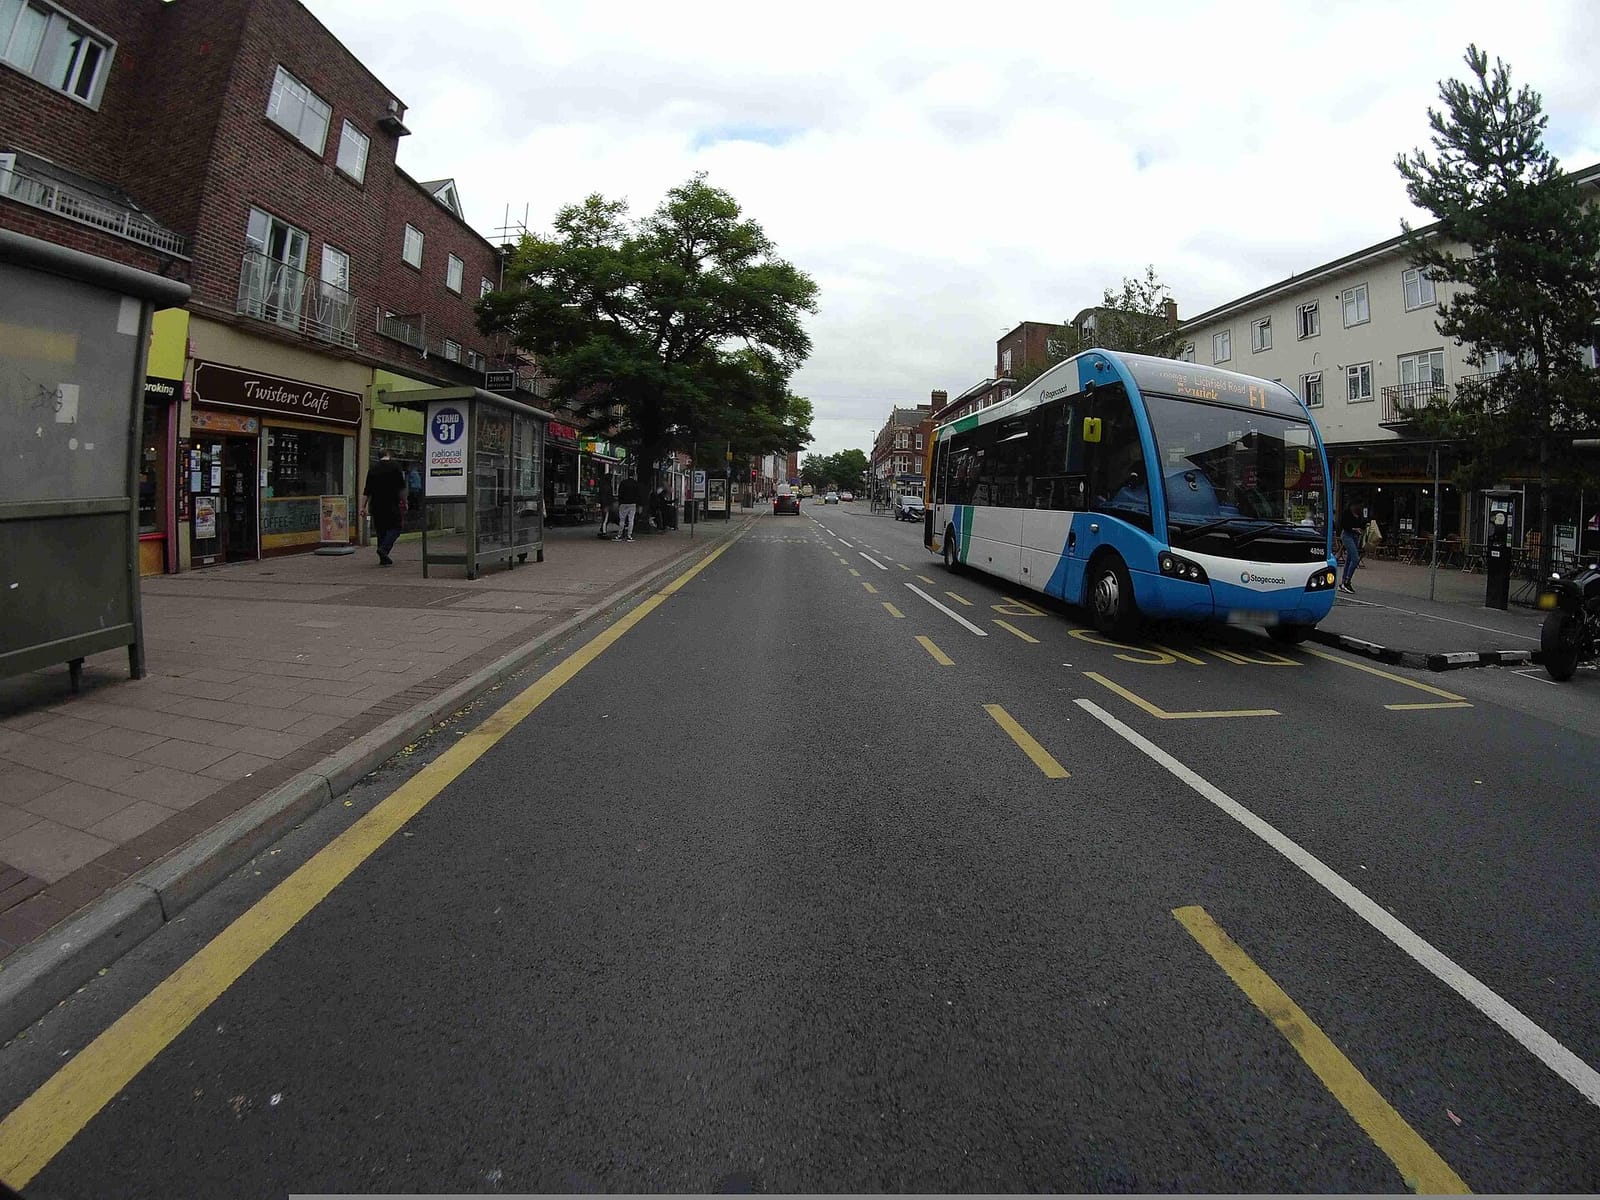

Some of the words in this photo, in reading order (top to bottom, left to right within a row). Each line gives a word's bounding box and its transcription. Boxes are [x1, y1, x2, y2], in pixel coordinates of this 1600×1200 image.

[1045, 384, 1069, 399] Stagecoach
[1228, 381, 1246, 394] Road
[244, 381, 300, 405] Twisters
[301, 391, 330, 414] Café
[1248, 384, 1266, 409] F1
[436, 413, 460, 424] STAND
[439, 424, 456, 441] 31
[432, 448, 462, 458] national
[432, 457, 462, 467] express
[262, 515, 288, 529] OFFEE
[1310, 547, 1325, 556] 48015
[1250, 574, 1286, 585] Stagecoach
